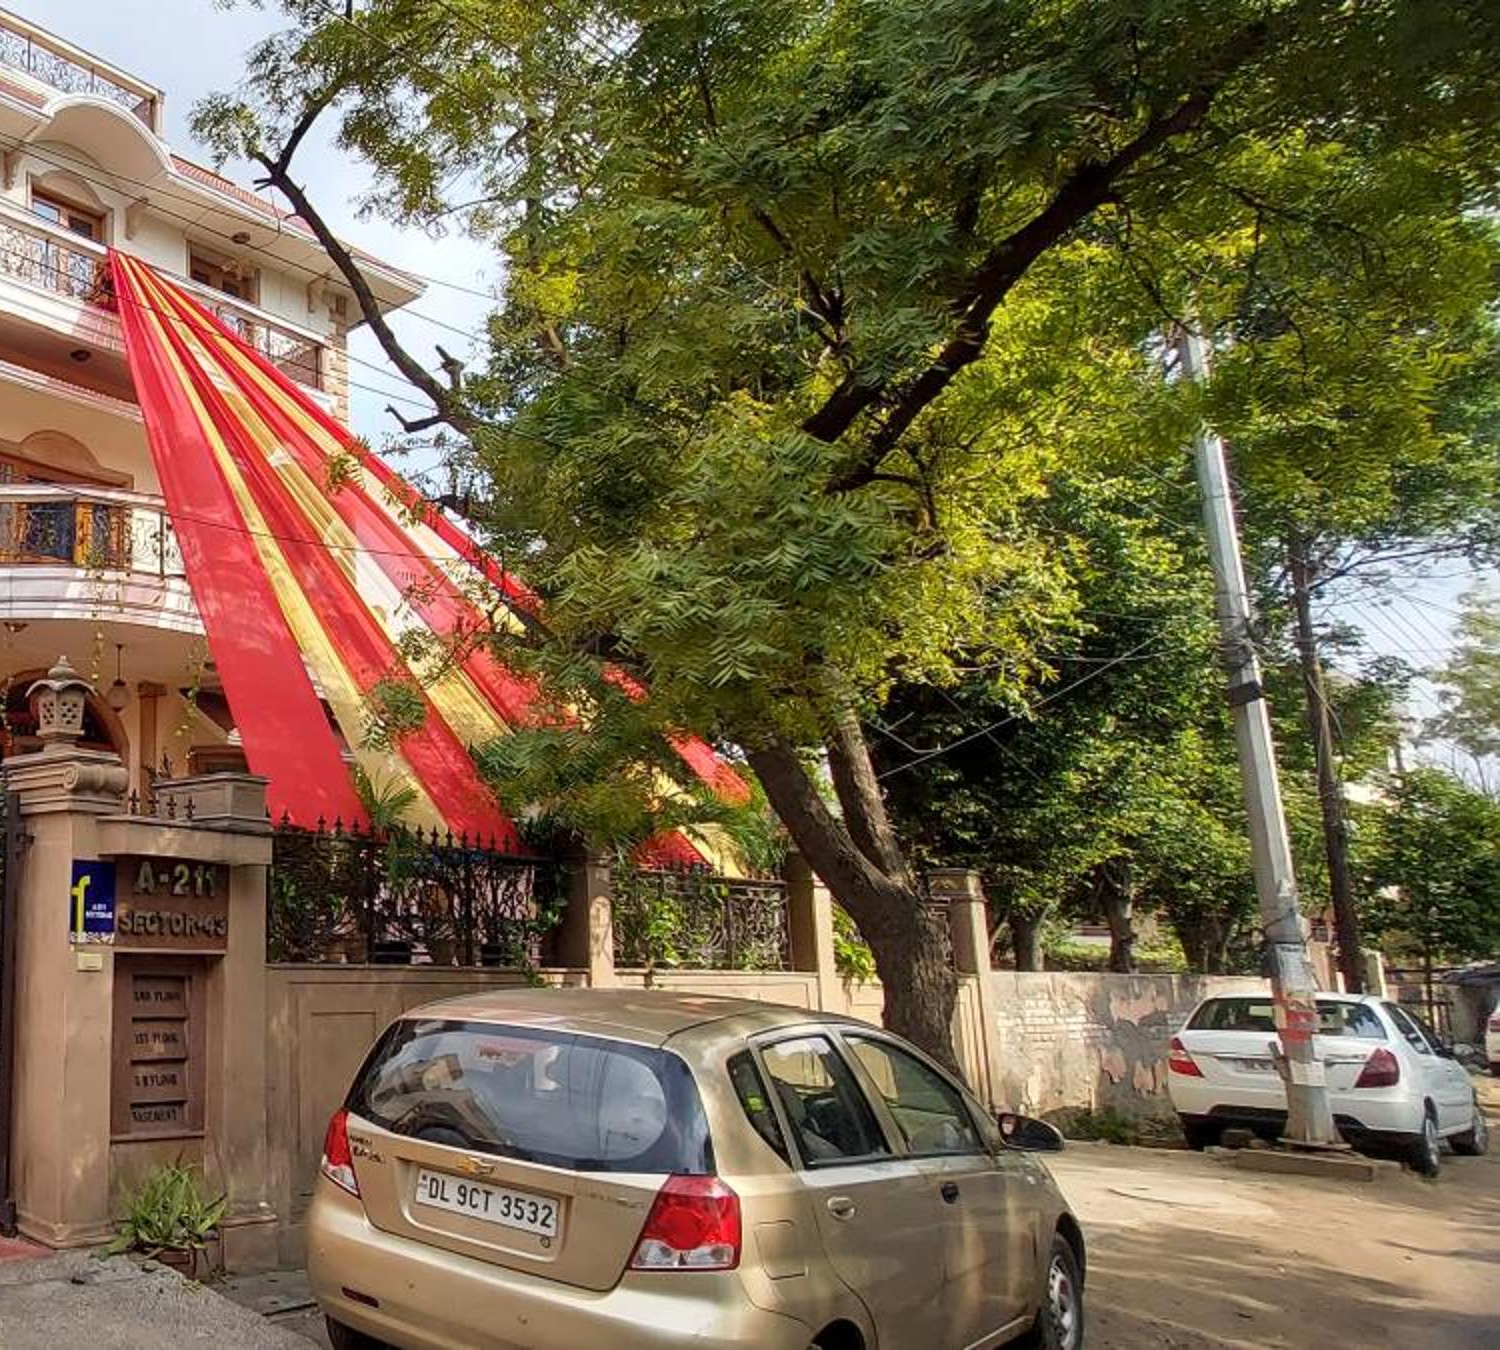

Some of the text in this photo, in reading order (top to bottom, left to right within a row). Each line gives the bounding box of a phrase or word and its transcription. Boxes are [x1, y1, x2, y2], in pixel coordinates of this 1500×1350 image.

[137, 861, 215, 897] A-211
[428, 1177, 553, 1229] DL 9CT 3532
